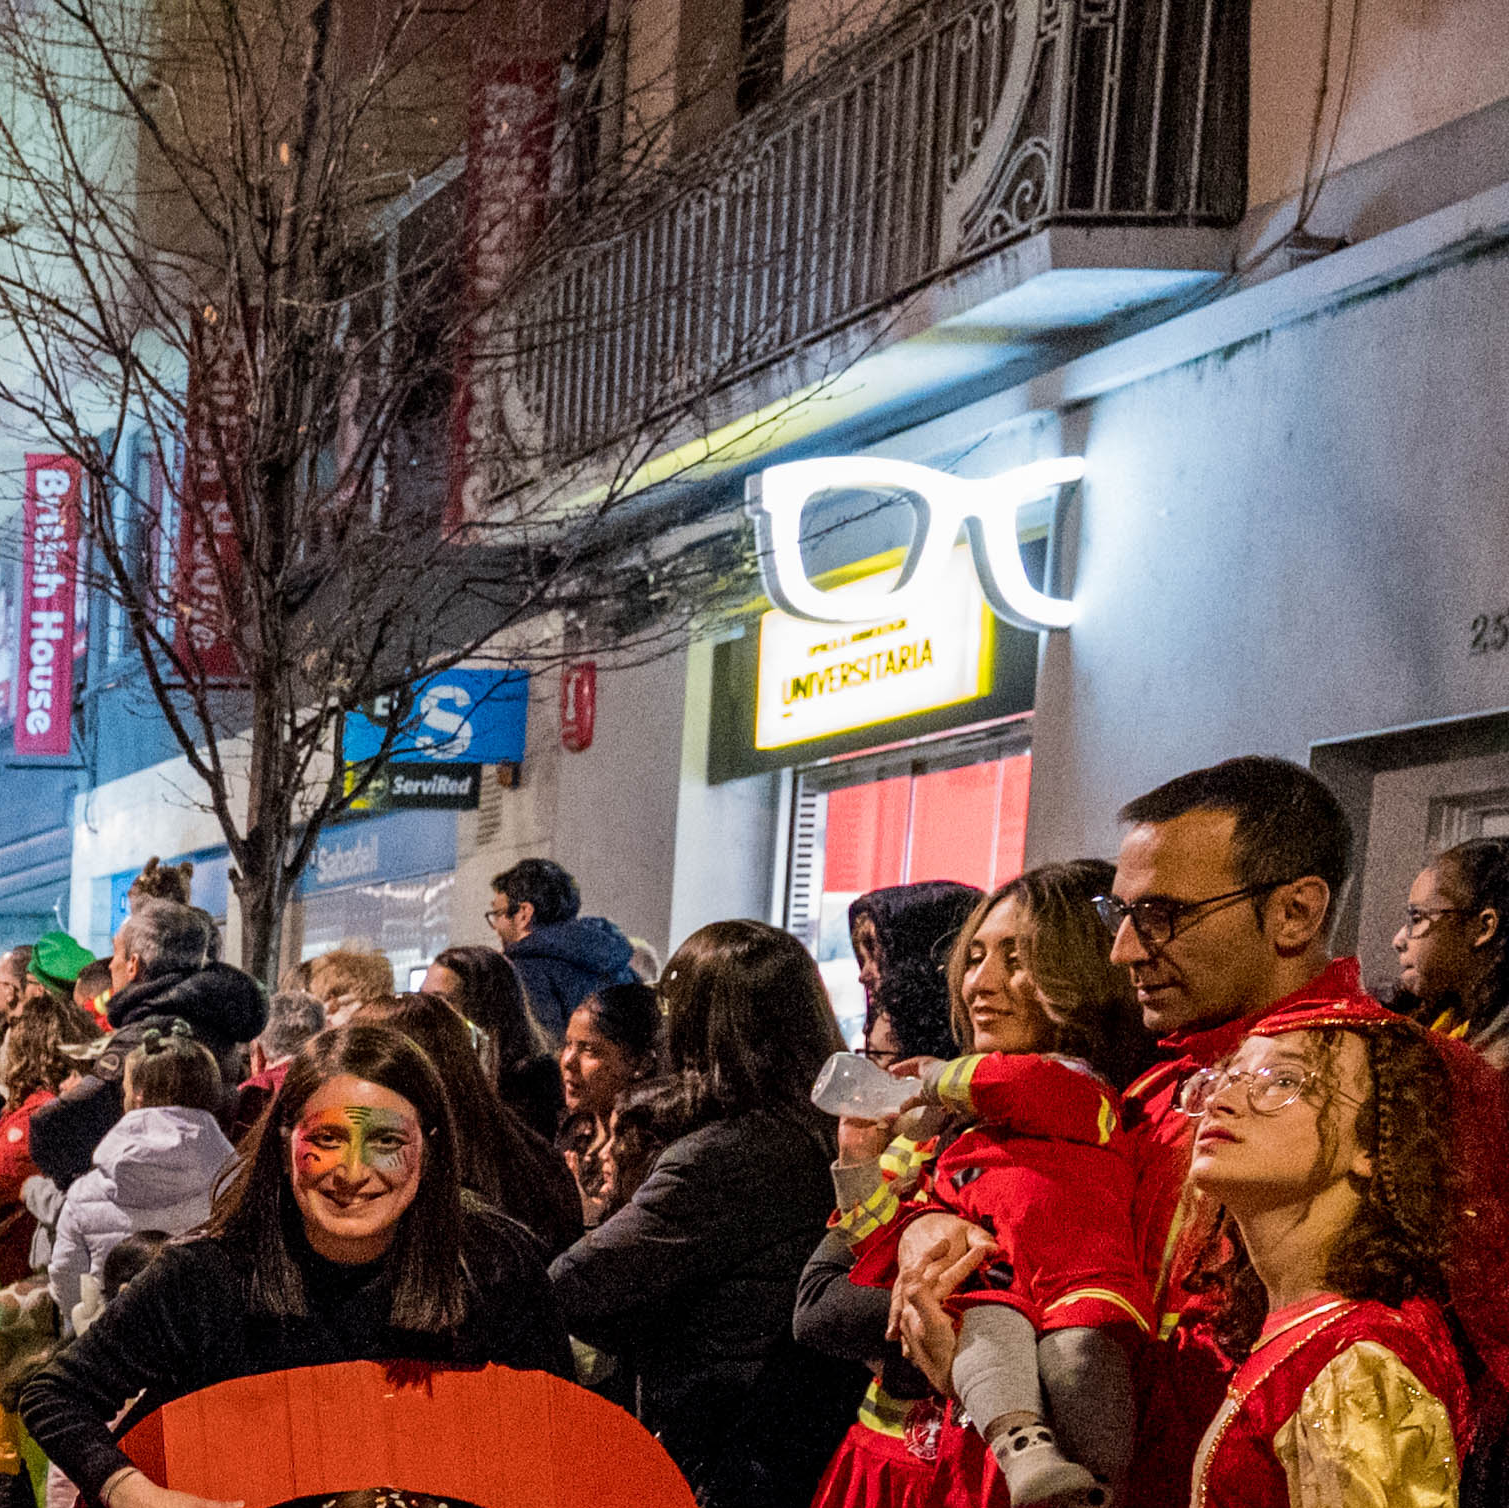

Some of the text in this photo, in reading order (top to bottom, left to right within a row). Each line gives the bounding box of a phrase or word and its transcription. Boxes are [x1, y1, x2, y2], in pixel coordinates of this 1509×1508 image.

[25, 469, 70, 735] British House
[783, 639, 932, 704] UNIVERSITARIA
[391, 773, 473, 795] ServiRed
